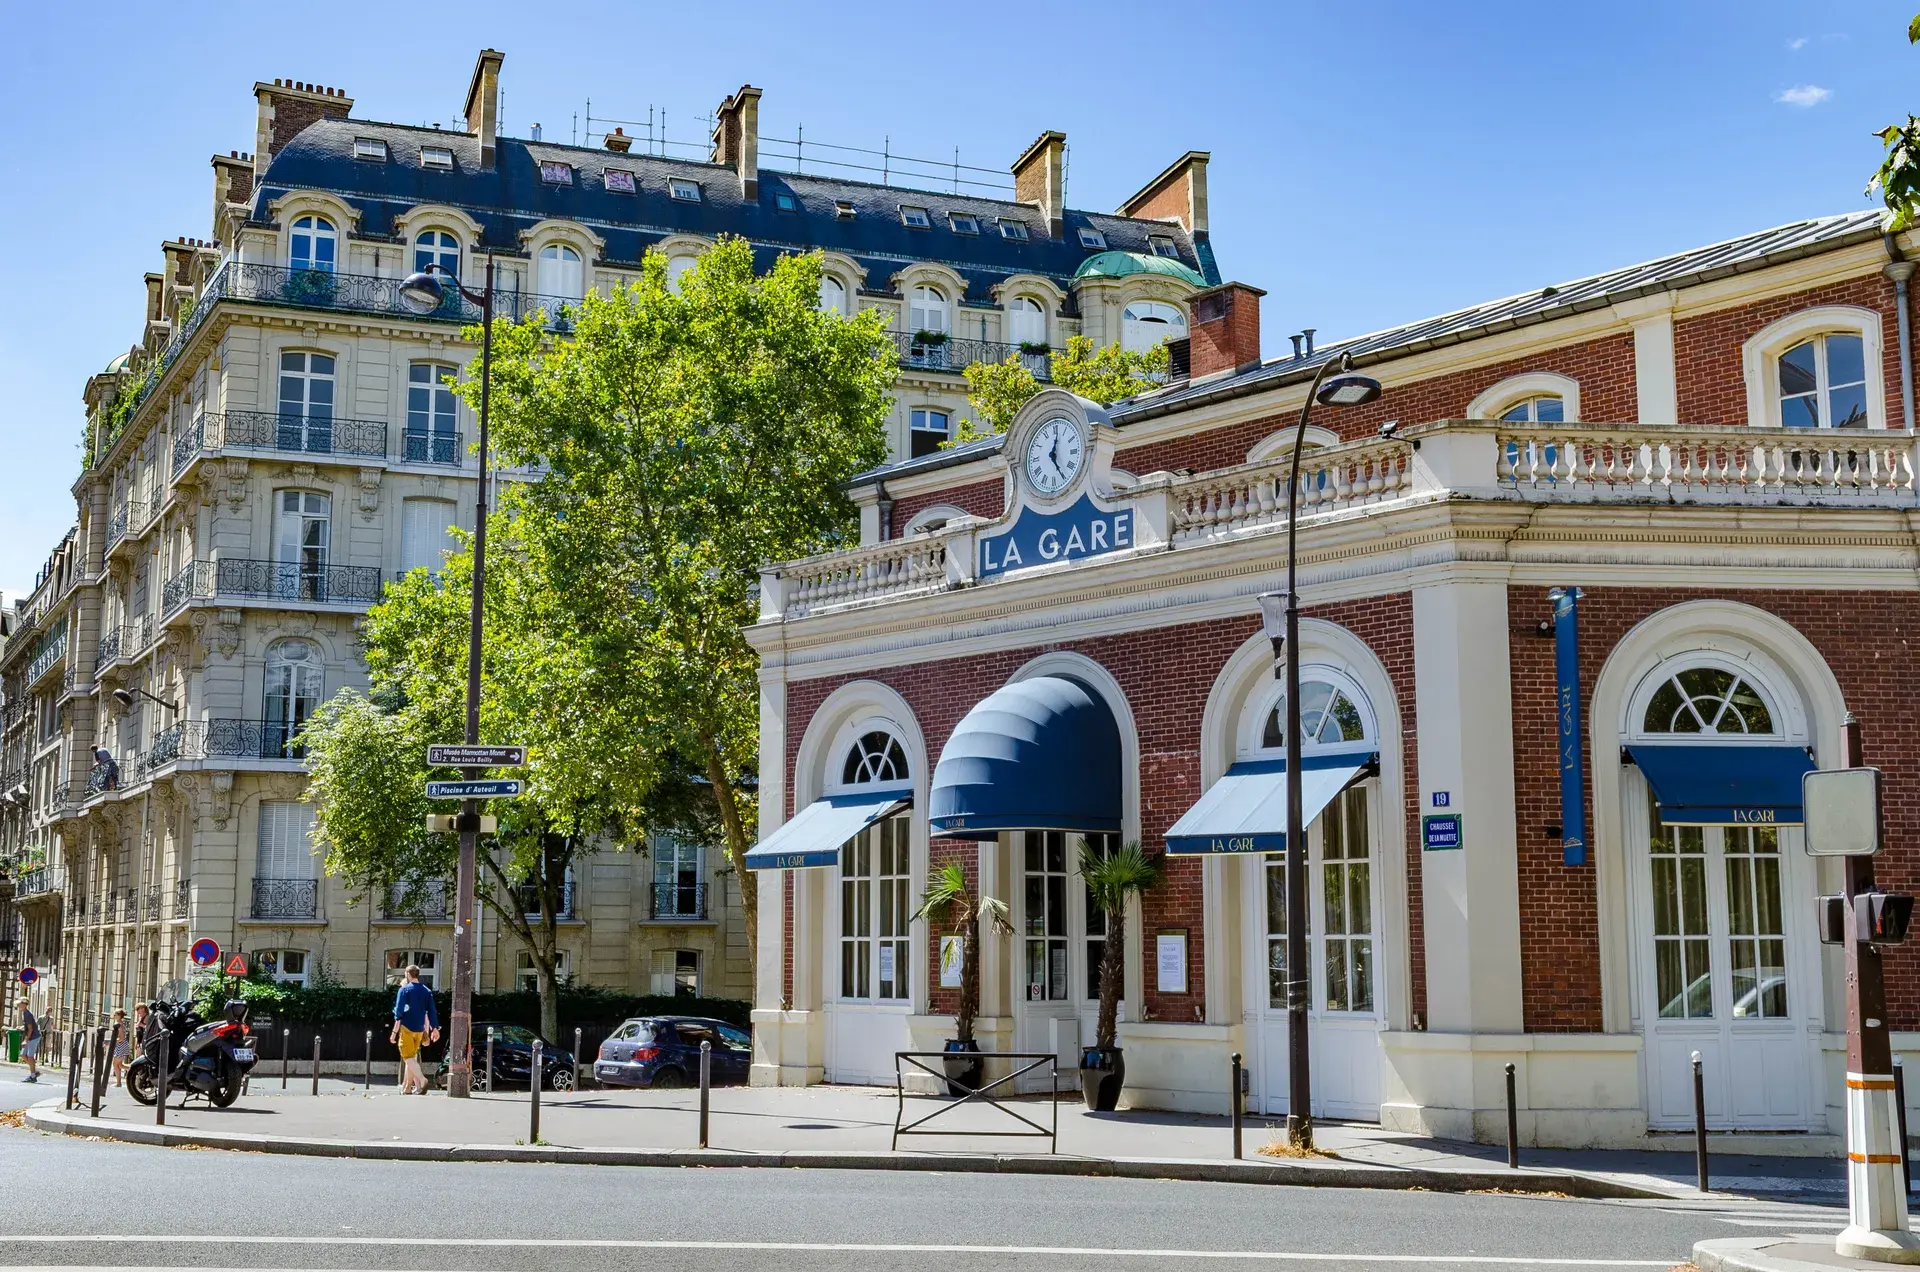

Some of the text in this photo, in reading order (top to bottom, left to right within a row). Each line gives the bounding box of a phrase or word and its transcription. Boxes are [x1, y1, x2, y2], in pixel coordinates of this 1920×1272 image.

[985, 514, 1129, 571] LA GARE
[1562, 684, 1573, 769] LA GARE
[489, 749, 506, 757] Monet
[473, 785, 497, 793] Auteuil
[1436, 793, 1447, 806] 19
[1440, 833, 1457, 842] MUETTE
[1212, 837, 1254, 852] LA GARE
[776, 855, 805, 868] LA GARE
